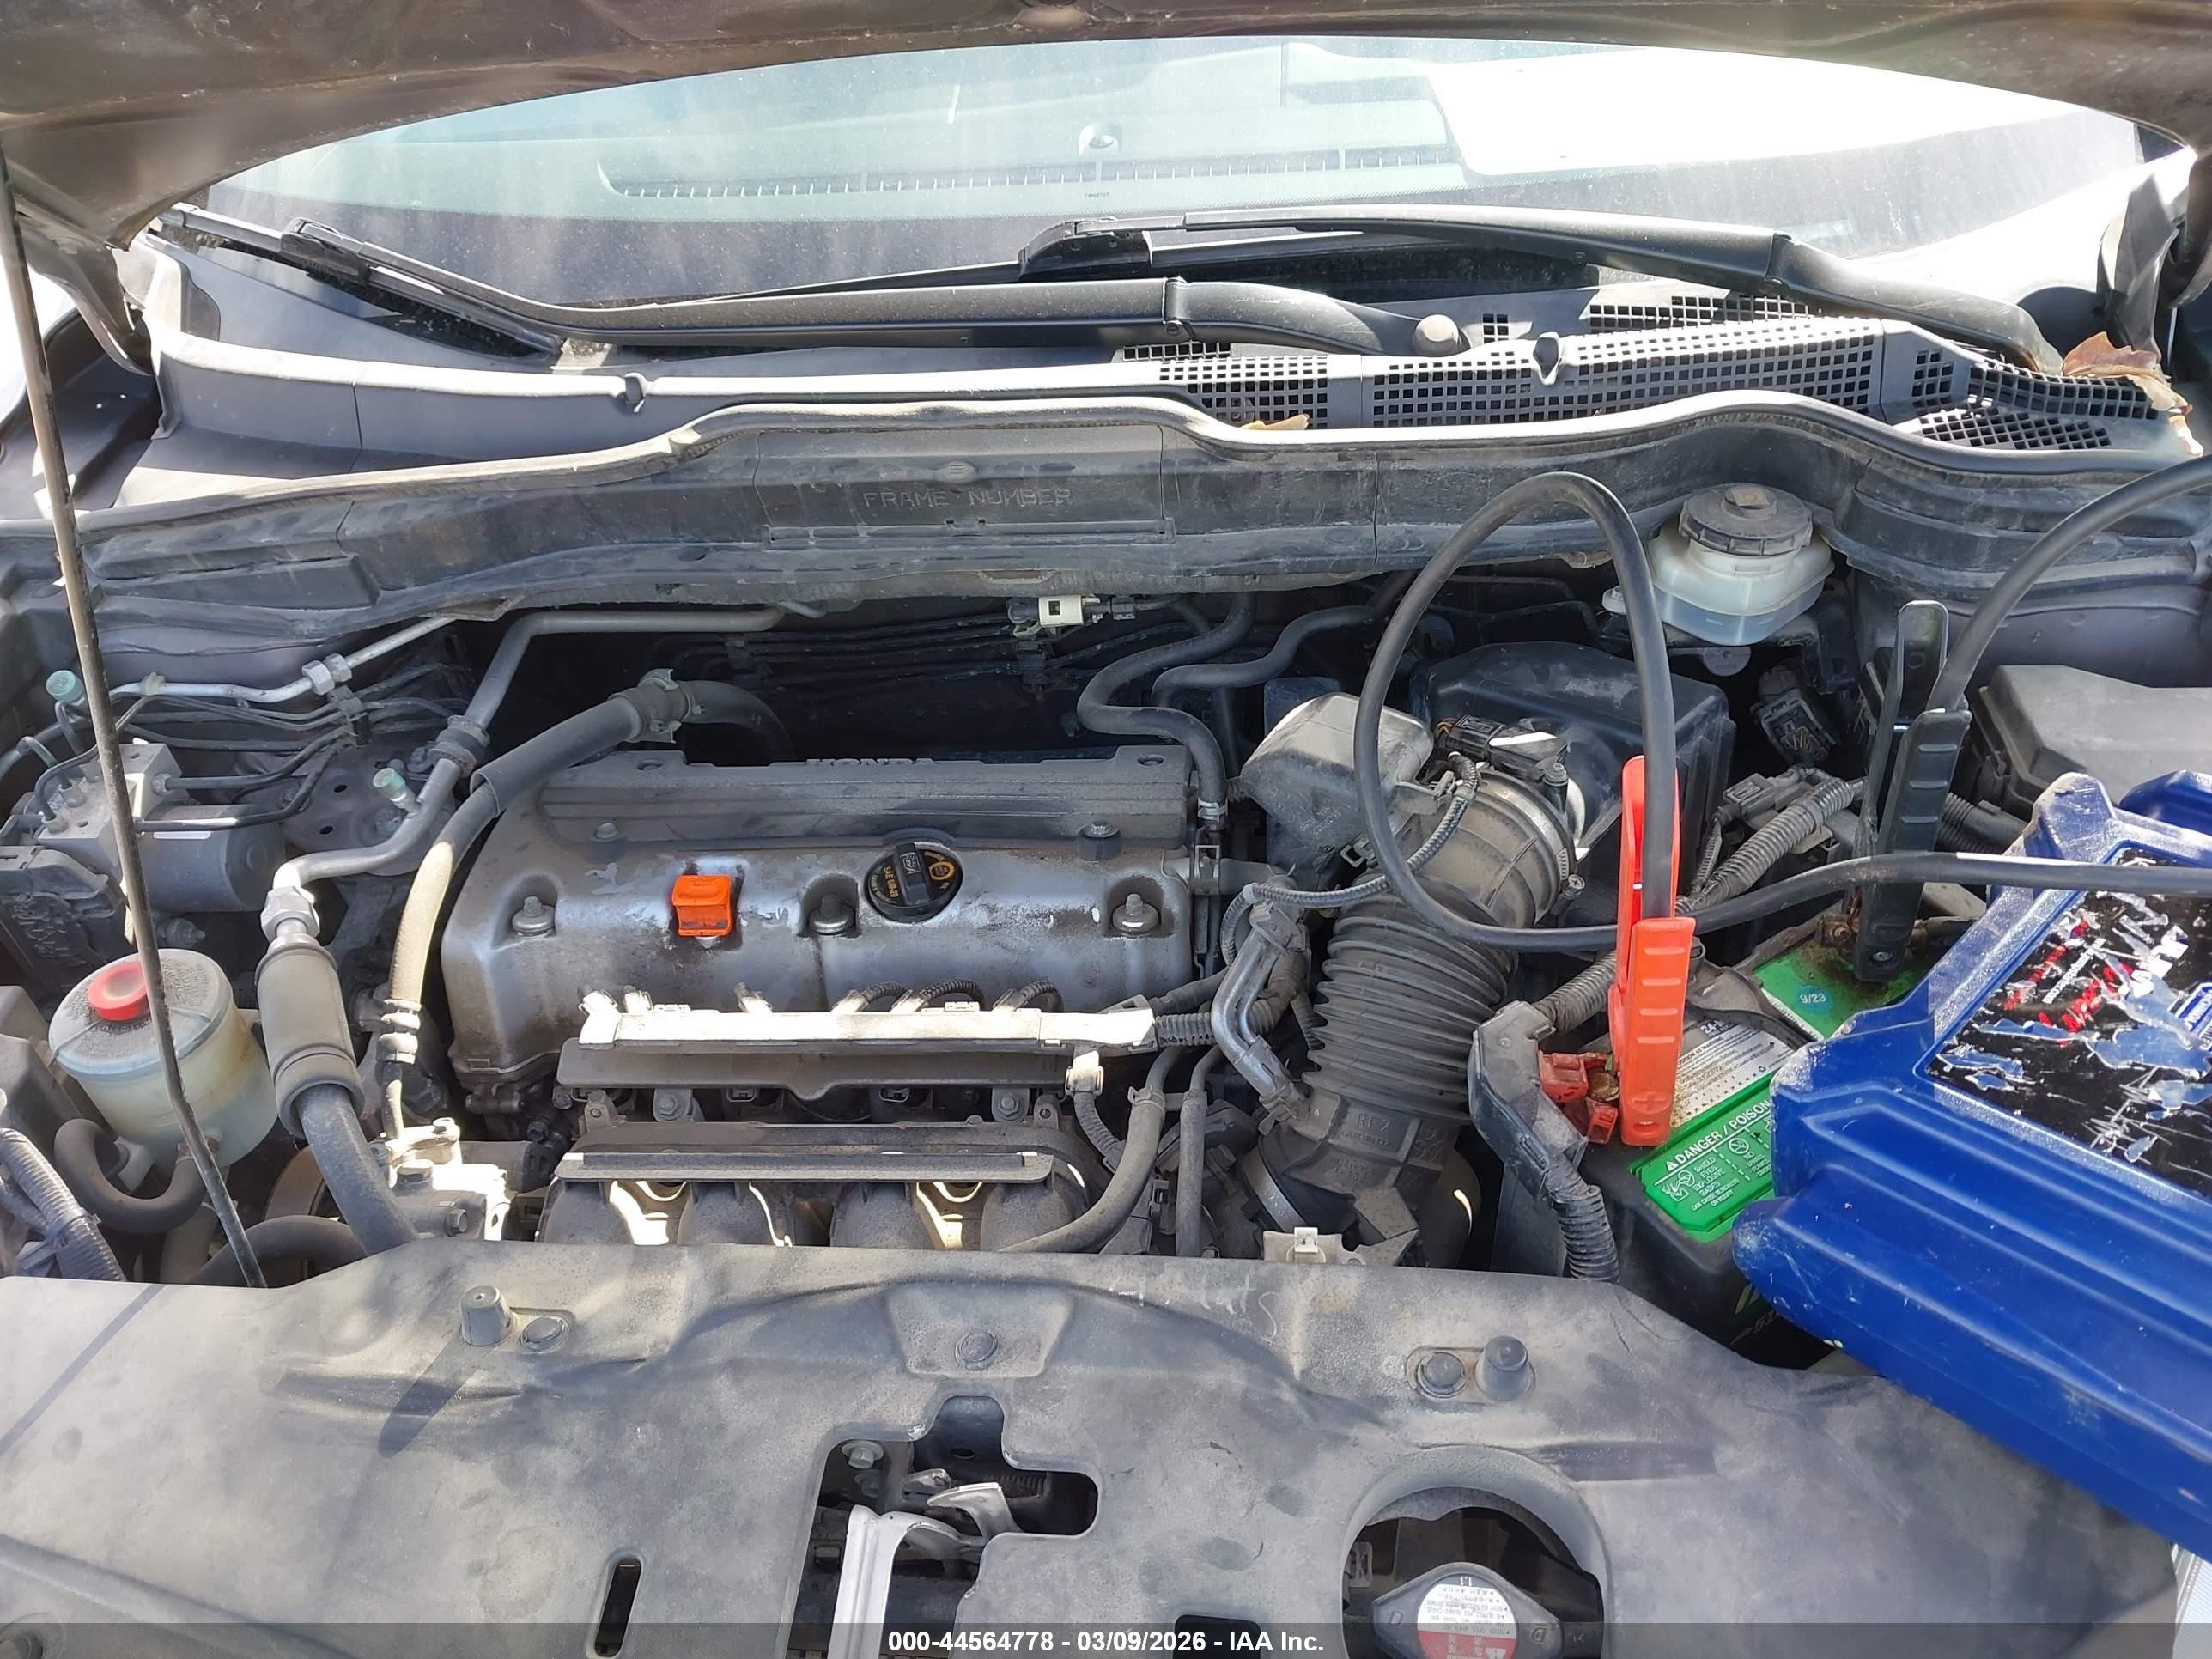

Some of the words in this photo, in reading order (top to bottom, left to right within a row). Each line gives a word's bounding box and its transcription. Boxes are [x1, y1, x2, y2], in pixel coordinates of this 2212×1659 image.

[861, 490, 950, 508] FRAME
[968, 487, 1072, 508] NUMBER
[882, 866, 894, 880] SAE
[1799, 992, 1827, 1004] 9/23
[1674, 1130, 1723, 1164] DANGER
[1723, 1124, 1729, 1135] /
[1728, 1100, 1770, 1130] POISON
[1693, 1156, 1717, 1173] SHIELD
[1699, 1165, 1717, 1178] EYES
[1692, 1168, 1726, 1192] EXPLOSIVE
[1698, 1182, 1721, 1196] GASES
